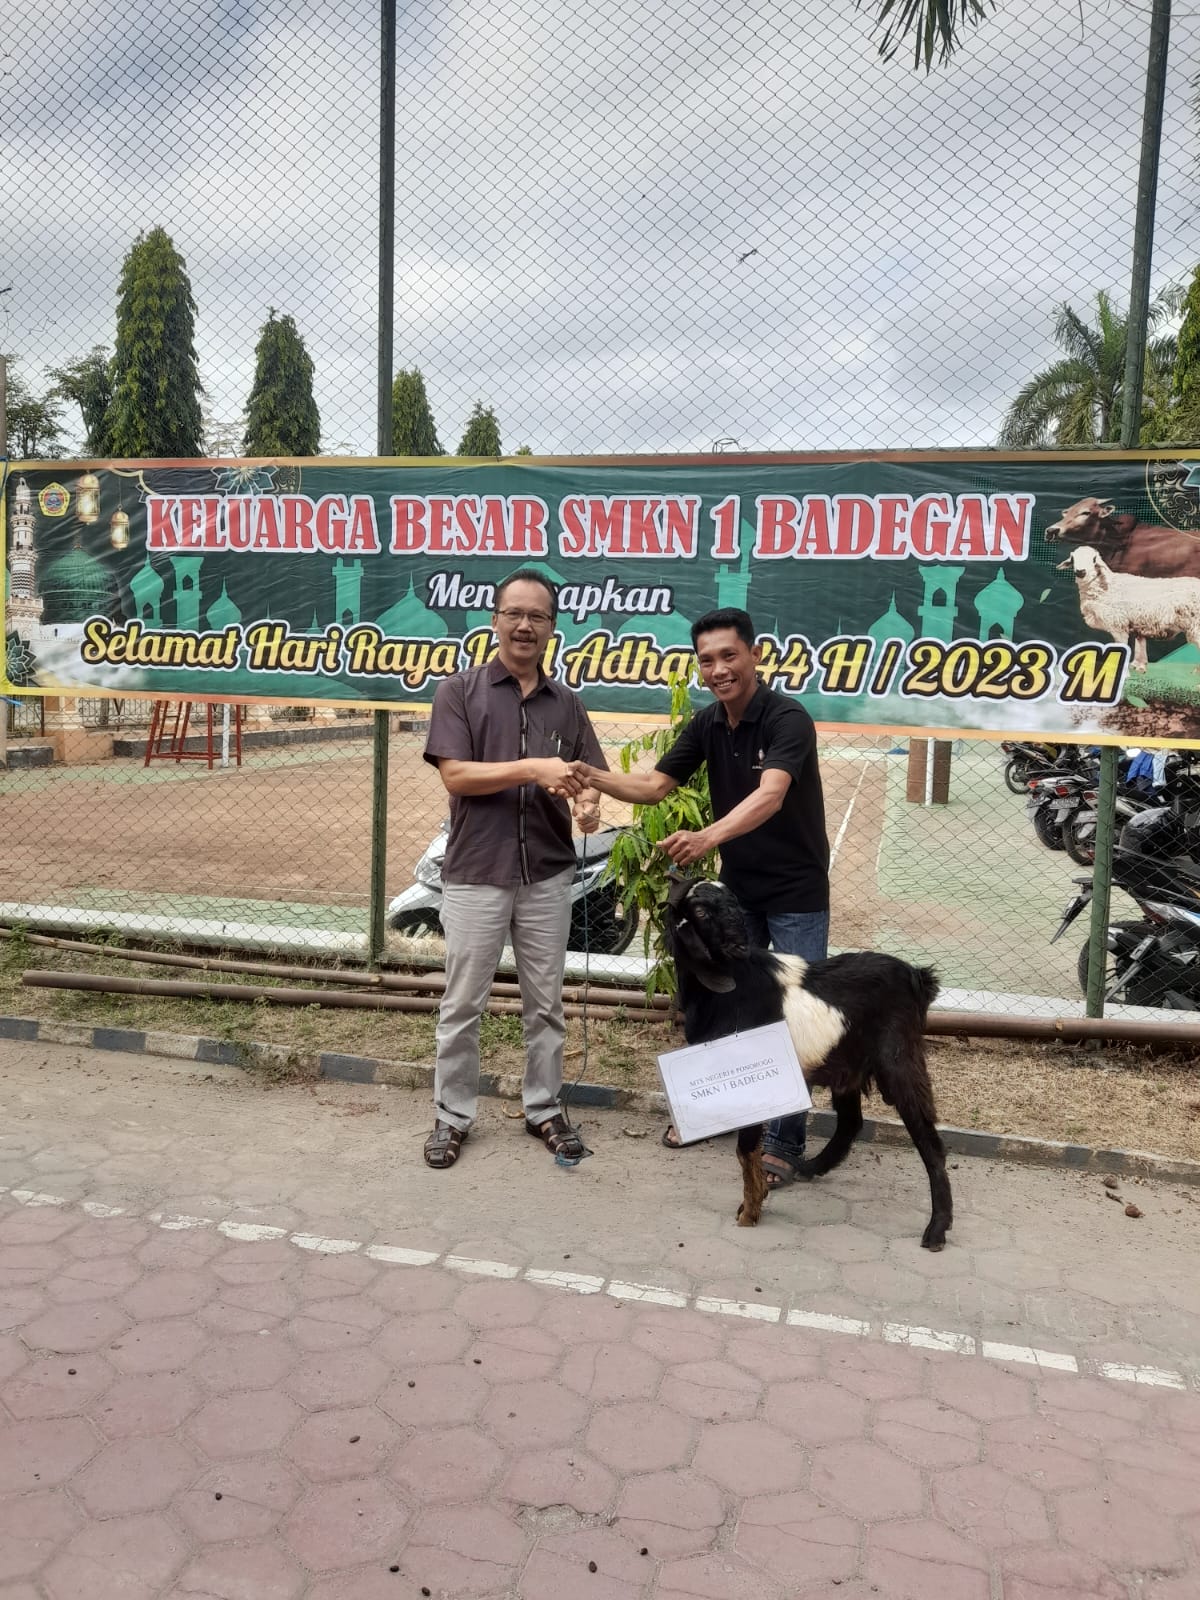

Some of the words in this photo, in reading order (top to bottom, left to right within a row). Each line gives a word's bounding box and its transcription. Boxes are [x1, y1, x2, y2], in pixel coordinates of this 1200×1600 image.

[148, 497, 379, 553] KELUARGA
[391, 497, 547, 555] BESAR
[561, 497, 698, 556] SMKN
[713, 498, 737, 556] 1
[757, 497, 1031, 559] BADEGAN
[427, 572, 673, 622] Menapkan
[82, 619, 239, 667] Selamat
[246, 624, 339, 672] Hari
[347, 627, 459, 687] Raya
[565, 633, 693, 690] Adha
[819, 640, 869, 692] H
[903, 642, 1051, 697] 2023
[1064, 647, 1125, 702] M
[690, 1085, 721, 1101] SMKN
[729, 1066, 780, 1089] BADEGAN
[704, 1069, 730, 1082] NEGERI
